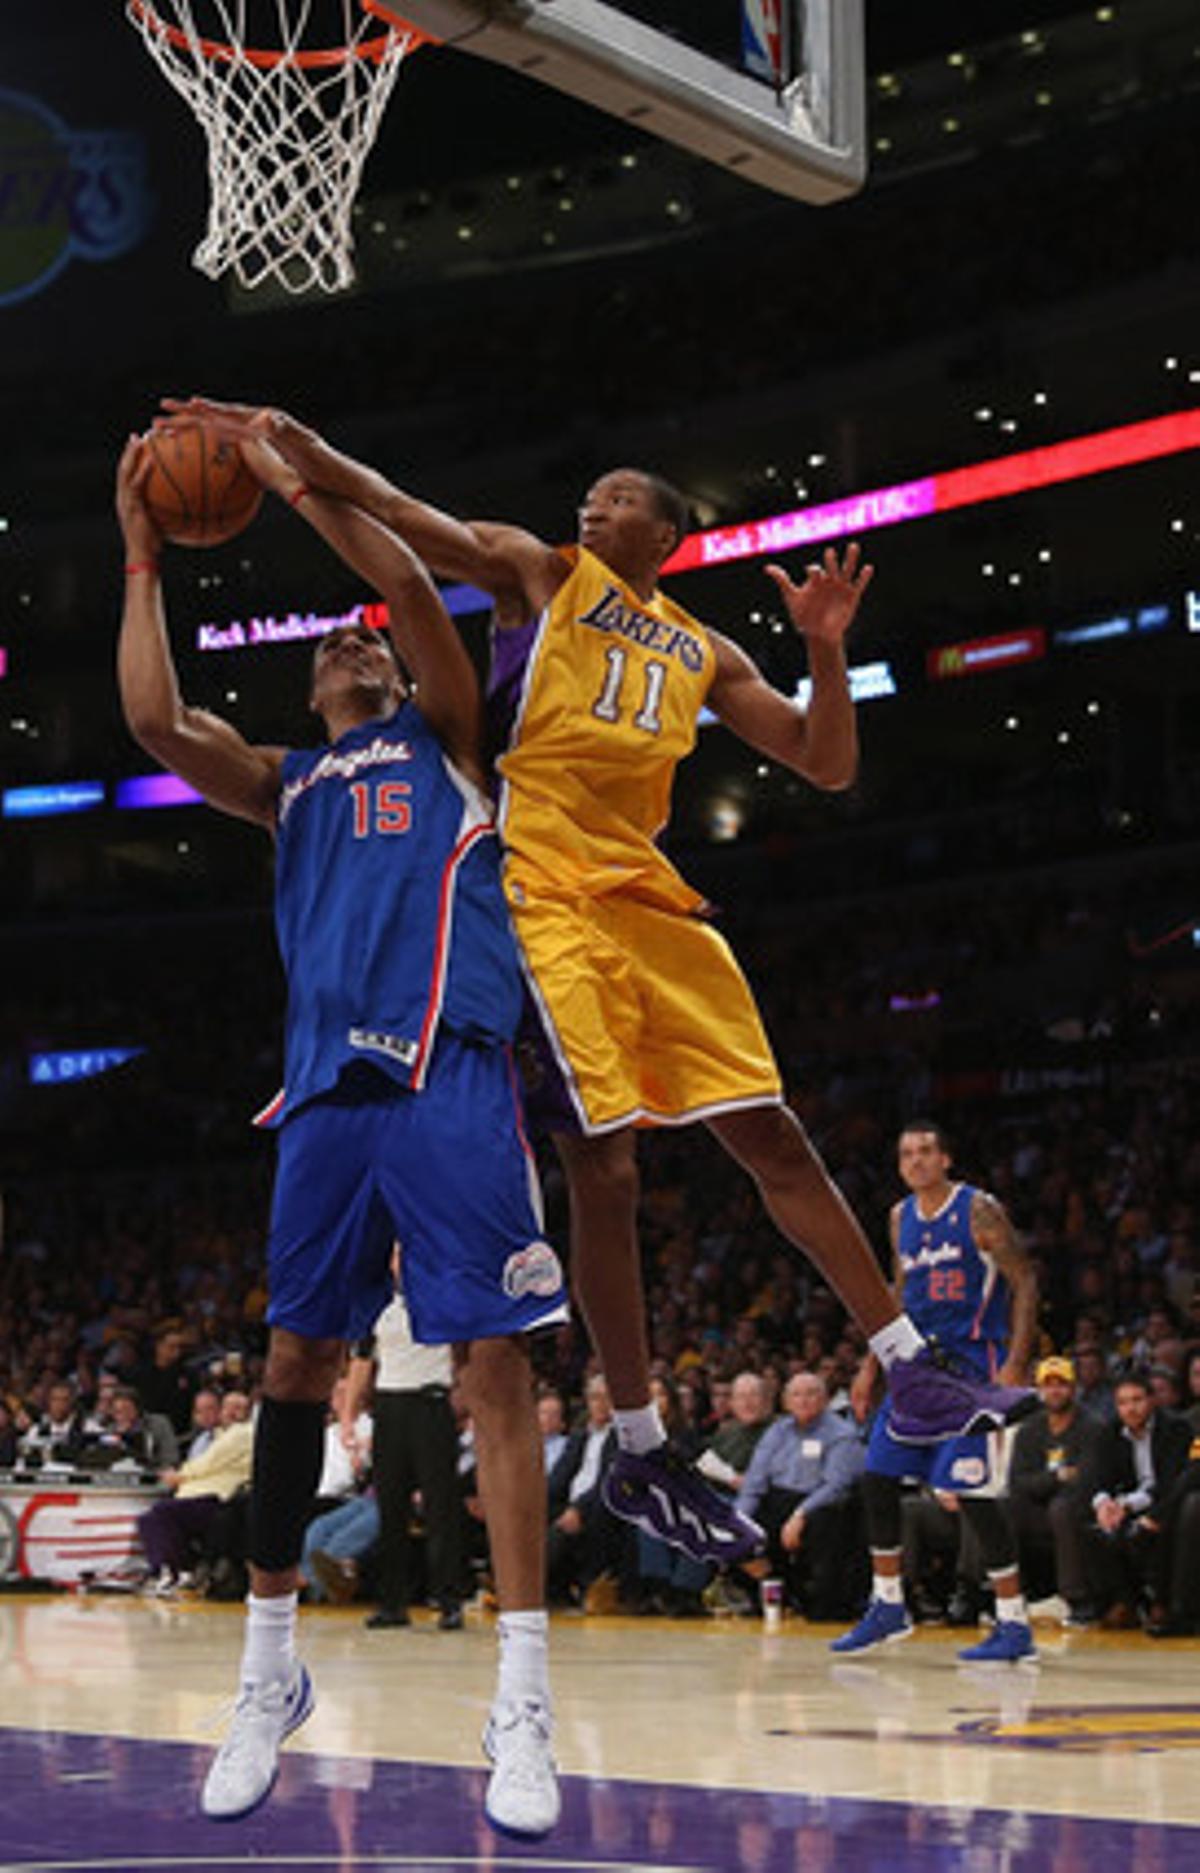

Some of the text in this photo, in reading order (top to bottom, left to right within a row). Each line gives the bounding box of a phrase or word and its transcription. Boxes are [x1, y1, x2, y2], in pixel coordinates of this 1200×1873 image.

[702, 526, 752, 562] Keck
[577, 583, 704, 672] LAKERS
[591, 645, 668, 737] 11
[304, 737, 413, 787] Angeles
[350, 780, 413, 838] 15
[928, 1269, 967, 1301] 22
